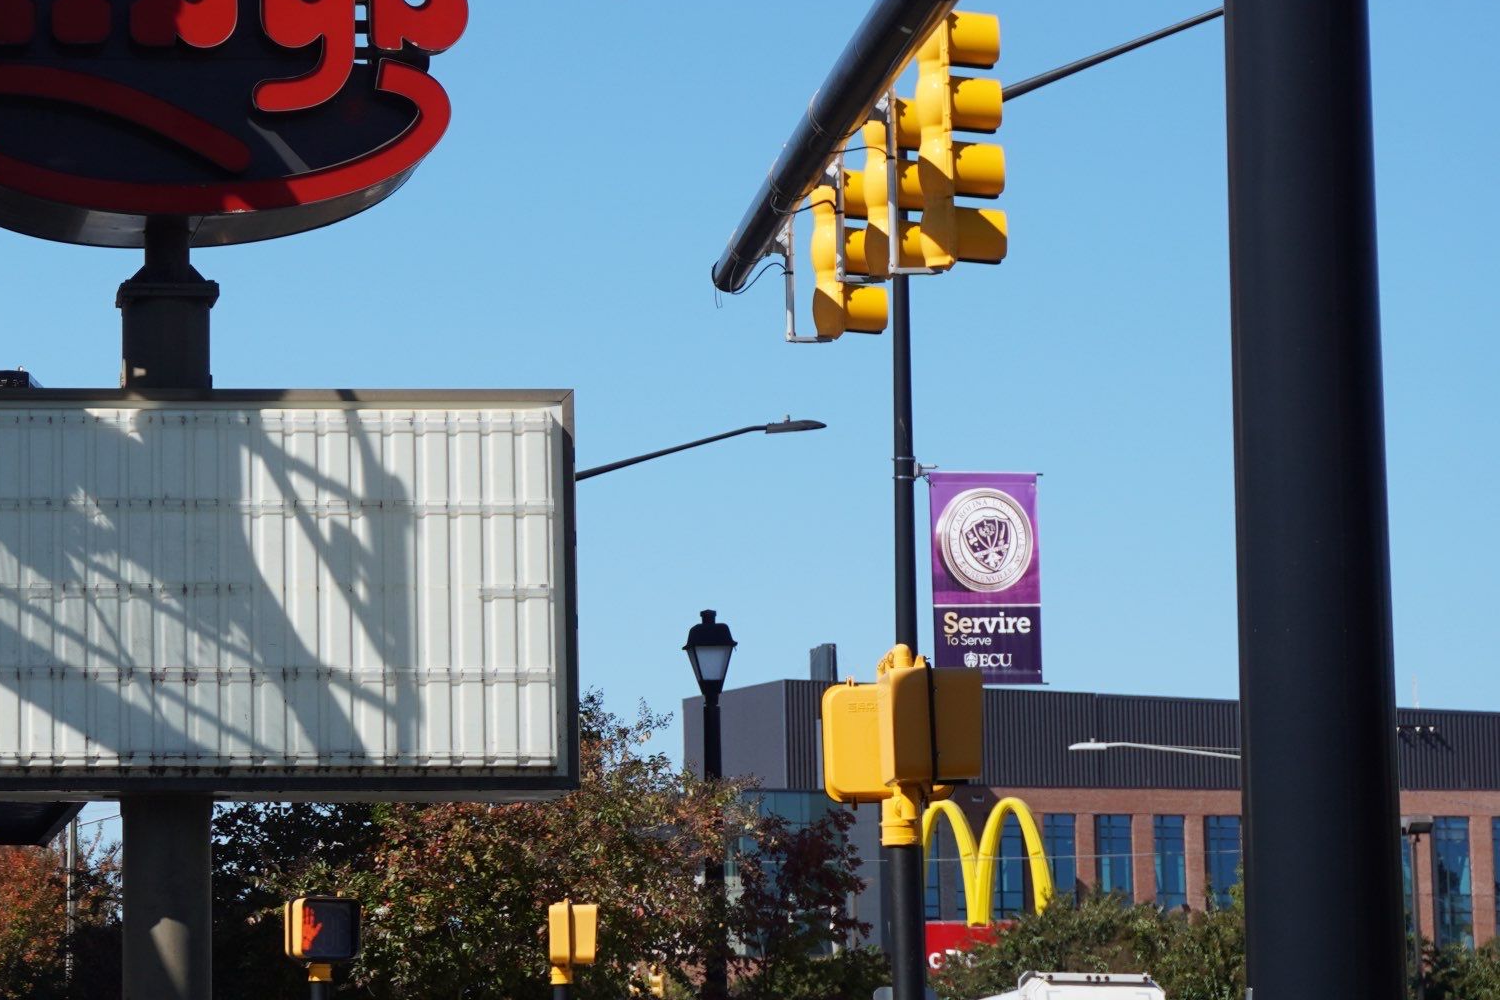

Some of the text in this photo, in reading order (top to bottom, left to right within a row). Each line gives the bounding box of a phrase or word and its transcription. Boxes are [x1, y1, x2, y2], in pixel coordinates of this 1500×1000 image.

[943, 611, 1031, 634] Servire
[945, 634, 992, 646] To Serve
[979, 653, 1012, 668] ECU
